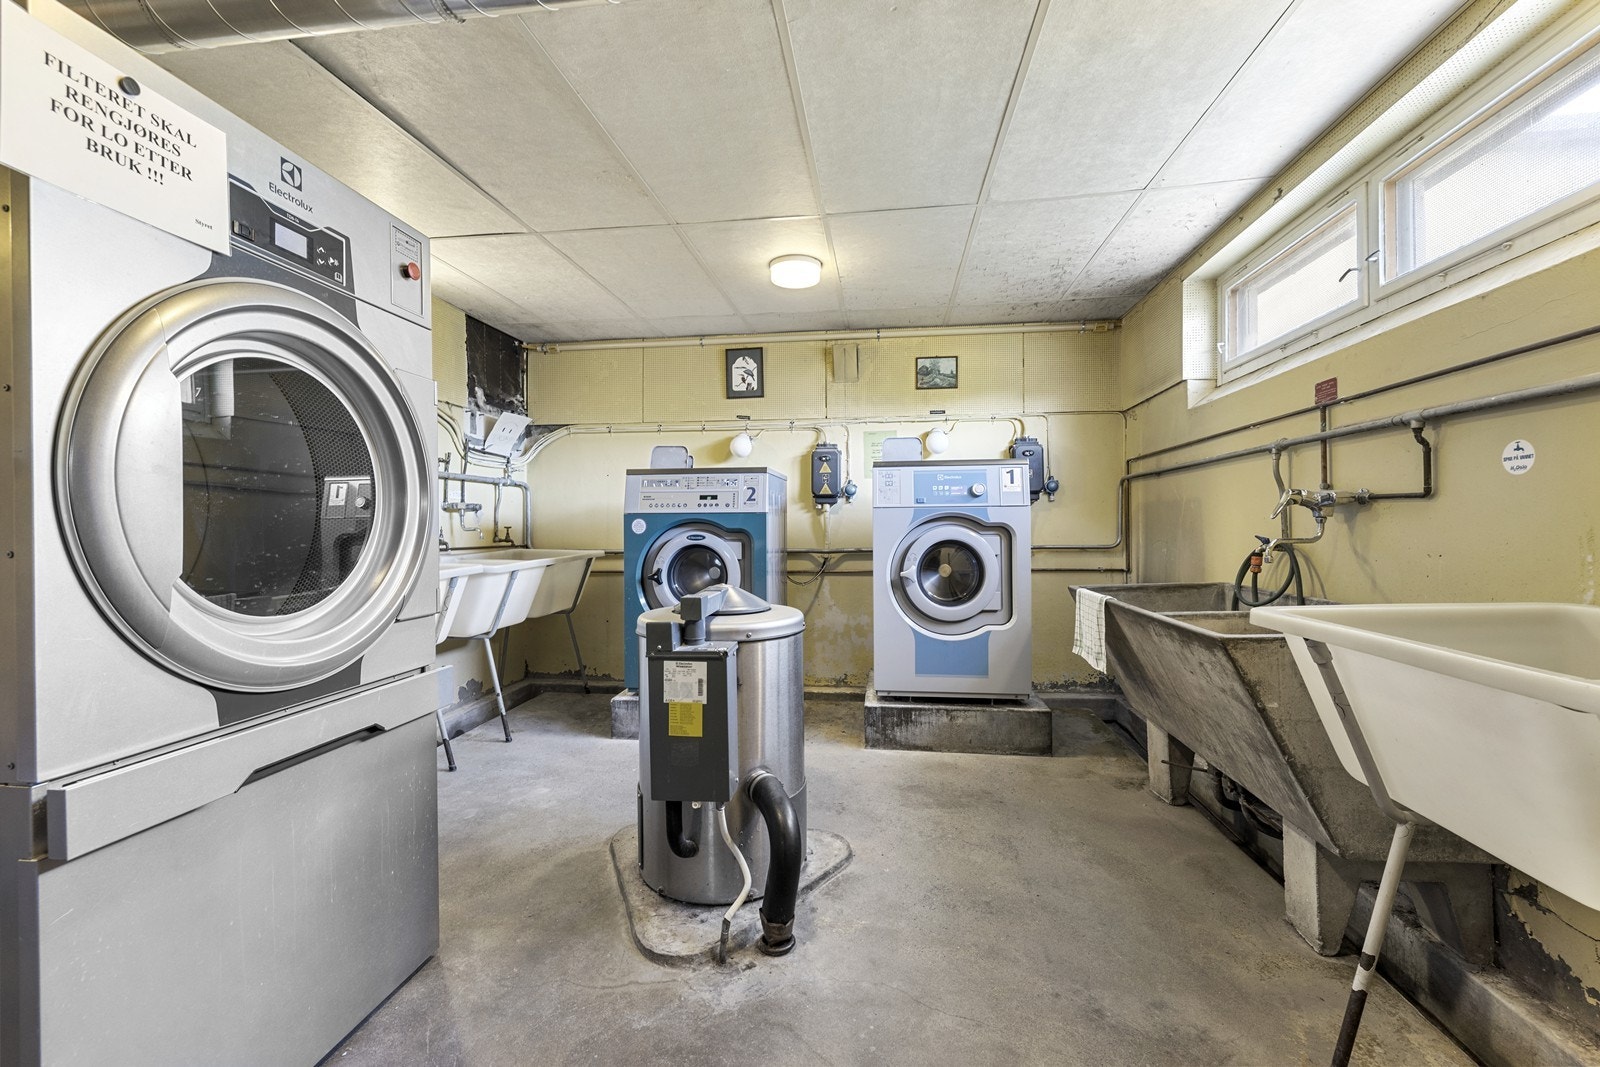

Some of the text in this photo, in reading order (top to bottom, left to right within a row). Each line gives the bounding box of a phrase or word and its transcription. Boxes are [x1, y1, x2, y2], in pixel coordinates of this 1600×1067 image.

[43, 50, 197, 148] FILTERET SKAL
[50, 97, 193, 181] FOR LO ETTER
[65, 84, 182, 157] RENGJØRES
[86, 136, 164, 185] BRUK !!!
[268, 181, 314, 214] Electrolux
[195, 218, 213, 230] Styret
[746, 487, 756, 501] 2
[1006, 469, 1014, 484] 1
